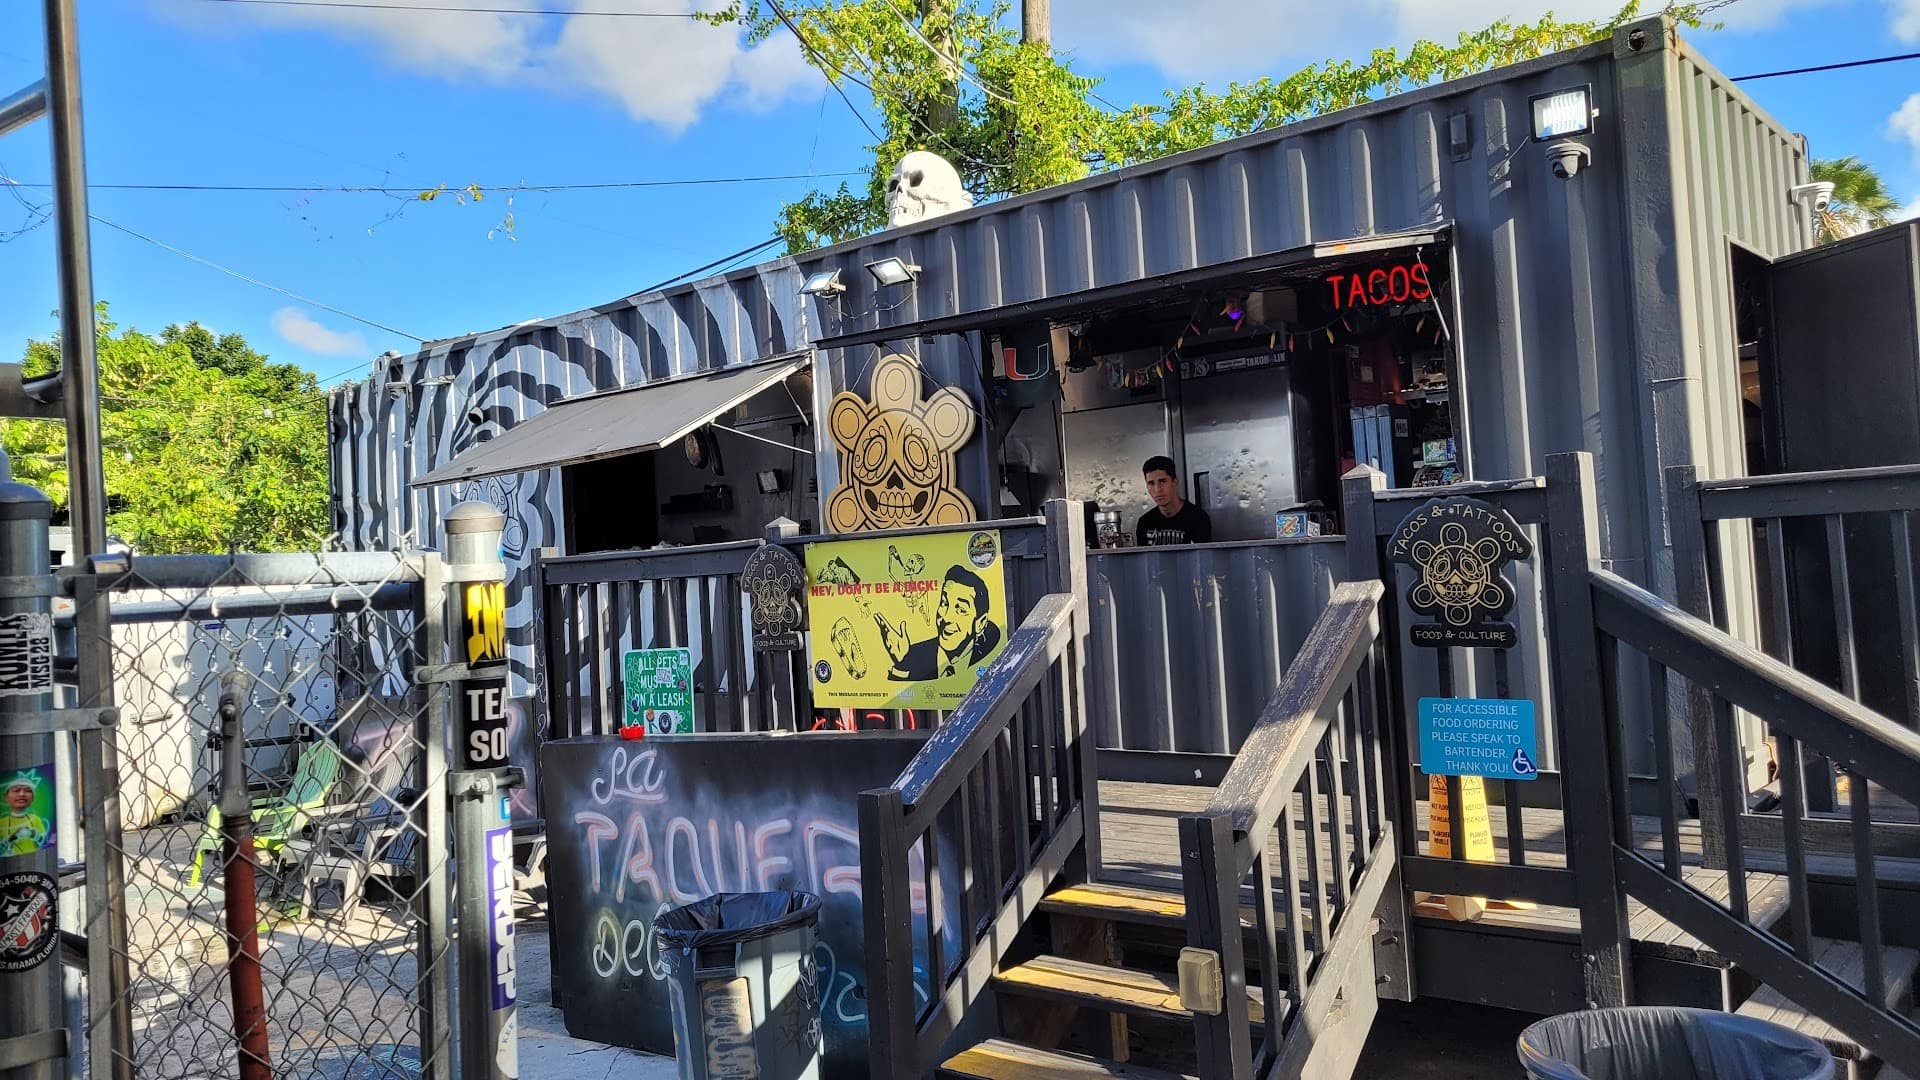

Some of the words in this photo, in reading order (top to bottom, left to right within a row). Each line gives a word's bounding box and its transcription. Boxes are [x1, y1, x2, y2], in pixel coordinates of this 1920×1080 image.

[1326, 262, 1430, 310] TACOS
[1003, 342, 1050, 381] U
[1393, 513, 1428, 557] TACOS
[1431, 505, 1447, 518] &
[1453, 503, 1520, 552] TATTOOS
[744, 558, 759, 588] TACOS
[760, 552, 767, 561] &
[811, 585, 835, 597] HEY,
[837, 583, 872, 596] DON'T
[875, 582, 890, 594] BE
[893, 581, 902, 593] A
[1415, 630, 1443, 640] FOOD
[1444, 631, 1456, 639] &
[1458, 631, 1508, 641] CULTURE
[638, 657, 654, 671] ALL
[656, 655, 678, 670] PETS
[634, 692, 646, 707] ON
[649, 693, 655, 707] A
[657, 692, 685, 707] LEASH
[1432, 703, 1452, 714] FOR
[1455, 704, 1518, 716] ACCESSIBLE
[1432, 717, 1461, 728] FOOD
[1463, 719, 1519, 730] ORDERING
[470, 727, 510, 763] SO
[1431, 732, 1469, 743] PLEASE
[1471, 733, 1504, 744] SPEAK
[1506, 734, 1521, 745] TO
[1445, 746, 1509, 759] BARTENDER.
[1446, 760, 1482, 773] THANK
[1483, 762, 1509, 774] YOU!
